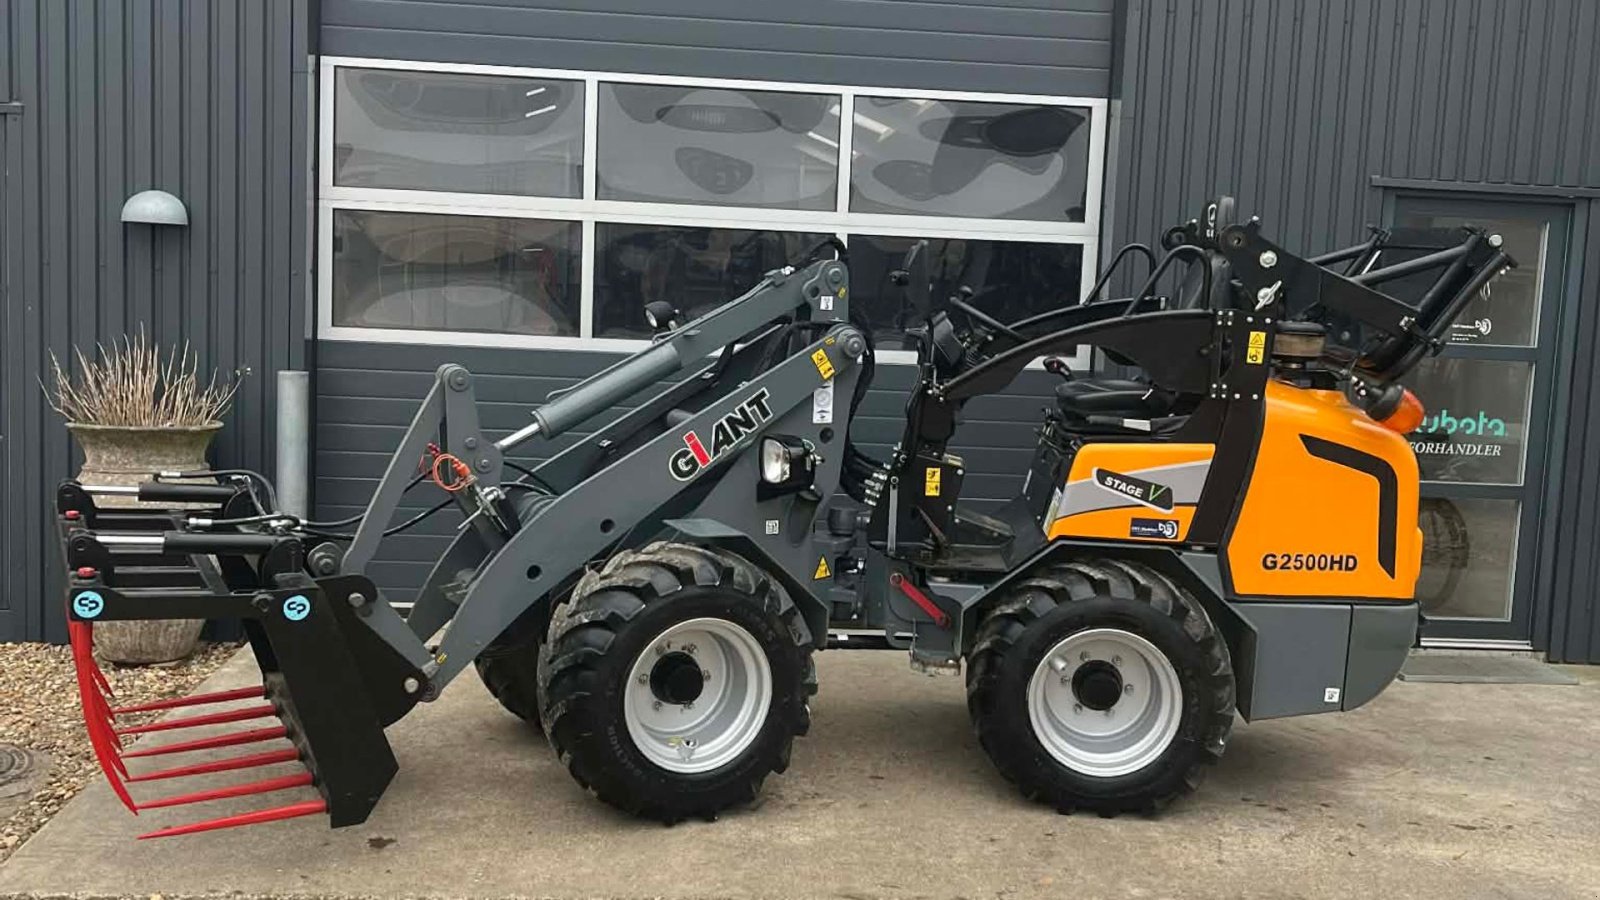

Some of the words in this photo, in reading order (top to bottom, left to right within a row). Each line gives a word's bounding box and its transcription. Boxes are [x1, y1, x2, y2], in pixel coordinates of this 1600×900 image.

[1415, 409, 1505, 436] ubota
[1104, 476, 1144, 498] STAGE
[1148, 484, 1169, 501] V
[1262, 553, 1358, 572] G2500HD
